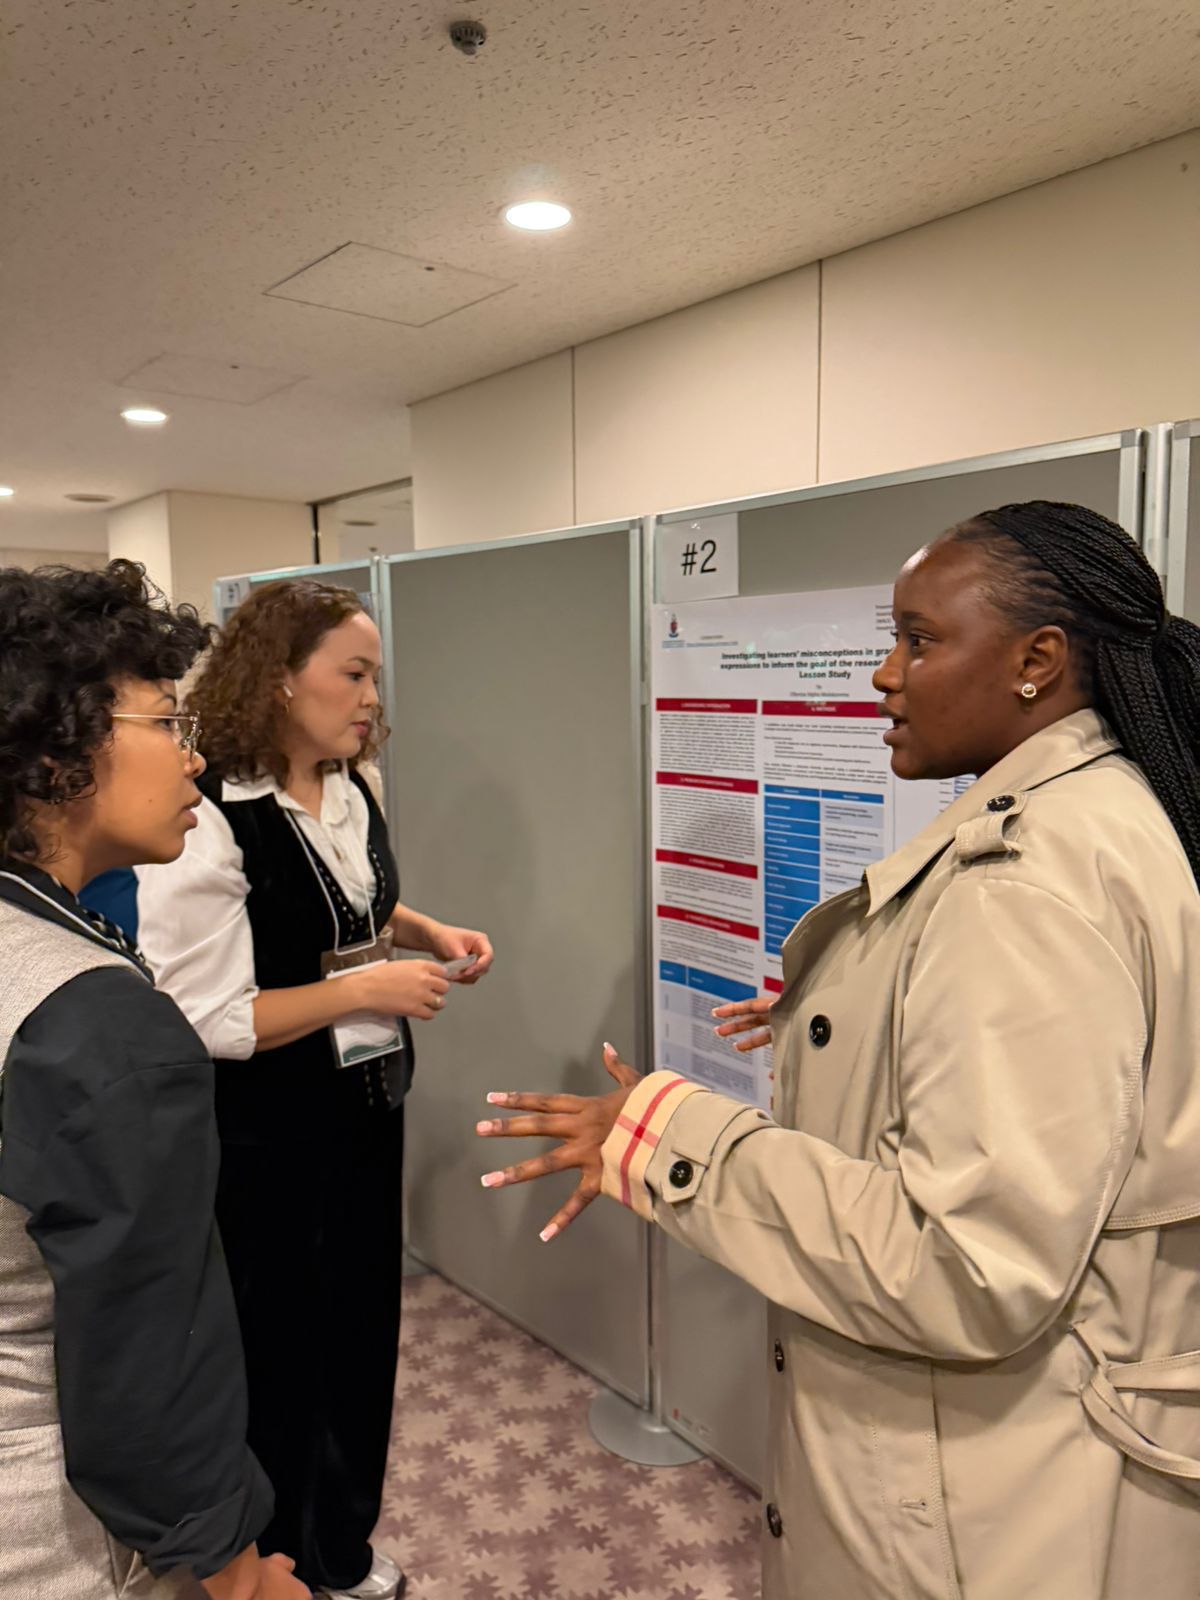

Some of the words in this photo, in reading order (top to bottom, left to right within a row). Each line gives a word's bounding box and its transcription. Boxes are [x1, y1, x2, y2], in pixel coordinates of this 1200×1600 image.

[681, 539, 717, 576] #2
[801, 648, 863, 657] misconceptions
[865, 647, 874, 655] in
[875, 648, 893, 657] gra
[720, 663, 761, 671] expressions
[762, 661, 769, 669] to
[771, 661, 794, 669] inform
[796, 660, 808, 668] the
[810, 660, 827, 670] goal
[829, 659, 837, 667] of
[839, 659, 852, 667] the
[828, 670, 851, 680] Study
